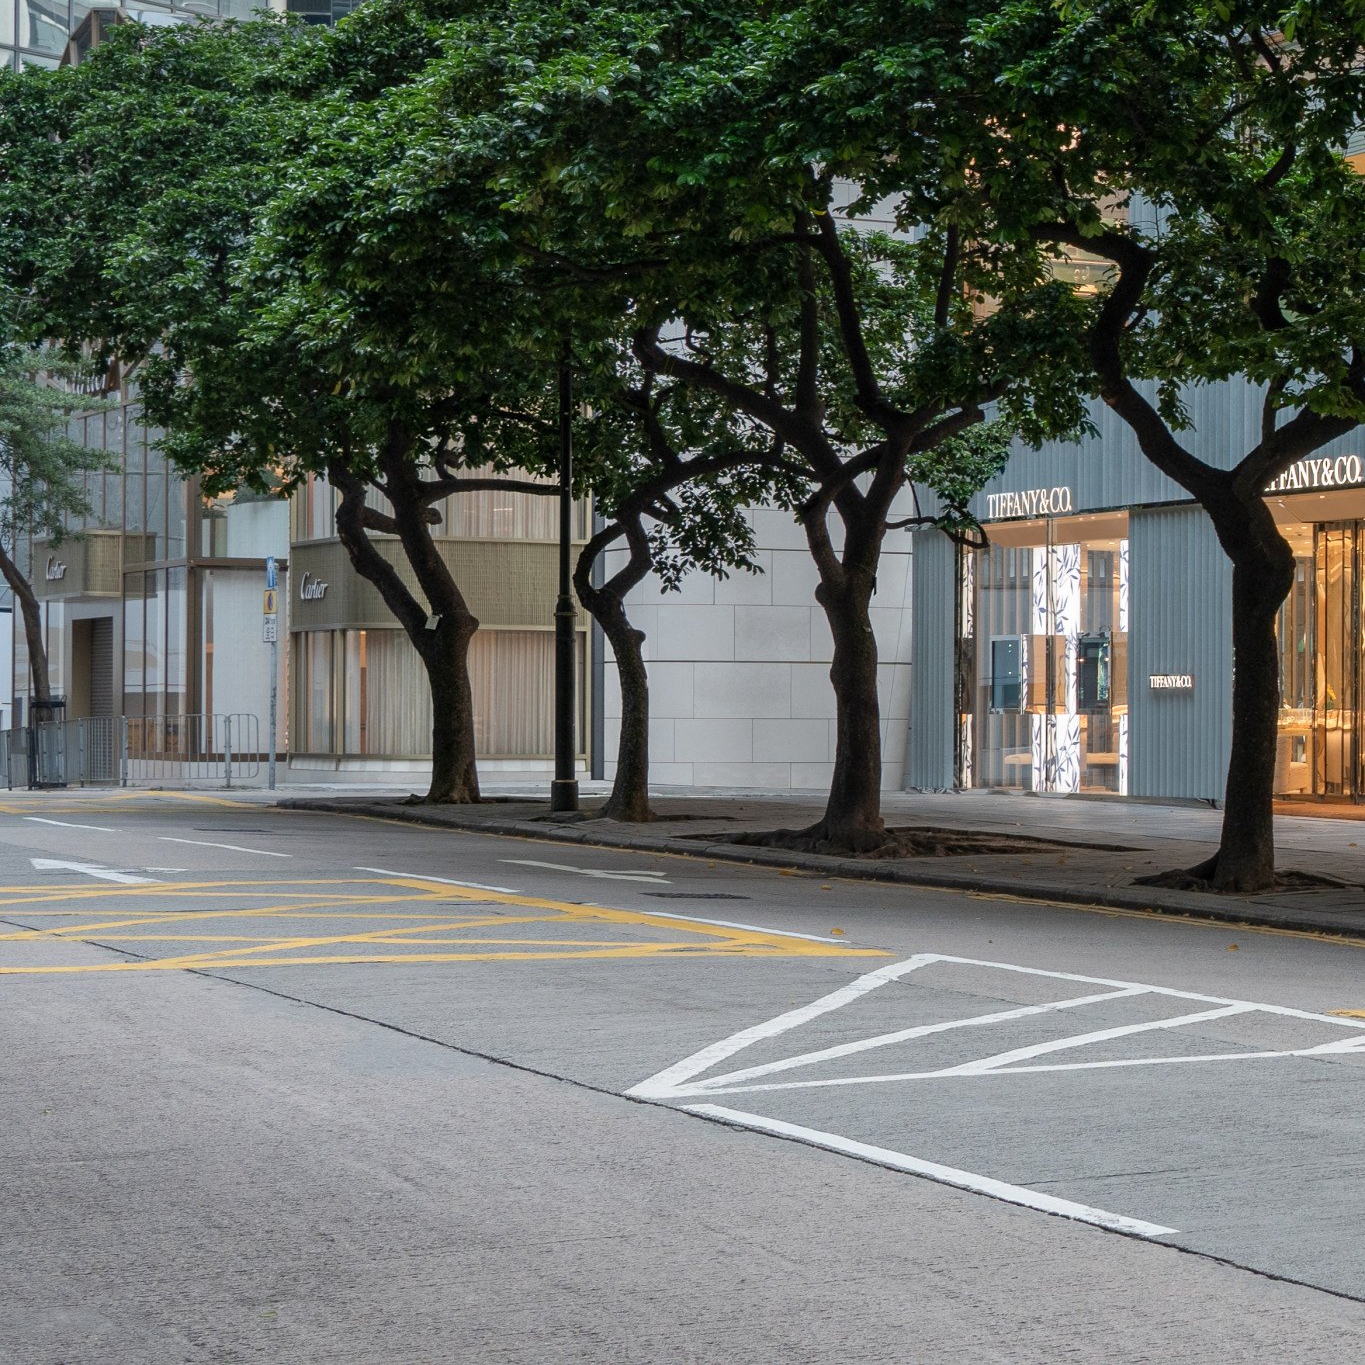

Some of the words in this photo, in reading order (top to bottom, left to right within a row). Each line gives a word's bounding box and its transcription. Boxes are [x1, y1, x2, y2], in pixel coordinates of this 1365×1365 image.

[1264, 455, 1363, 491] FANY&CO.
[987, 486, 1072, 518] TIFFANY&CO.
[300, 571, 329, 600] Cartier
[1149, 675, 1192, 688] TIFFANY&CO.
